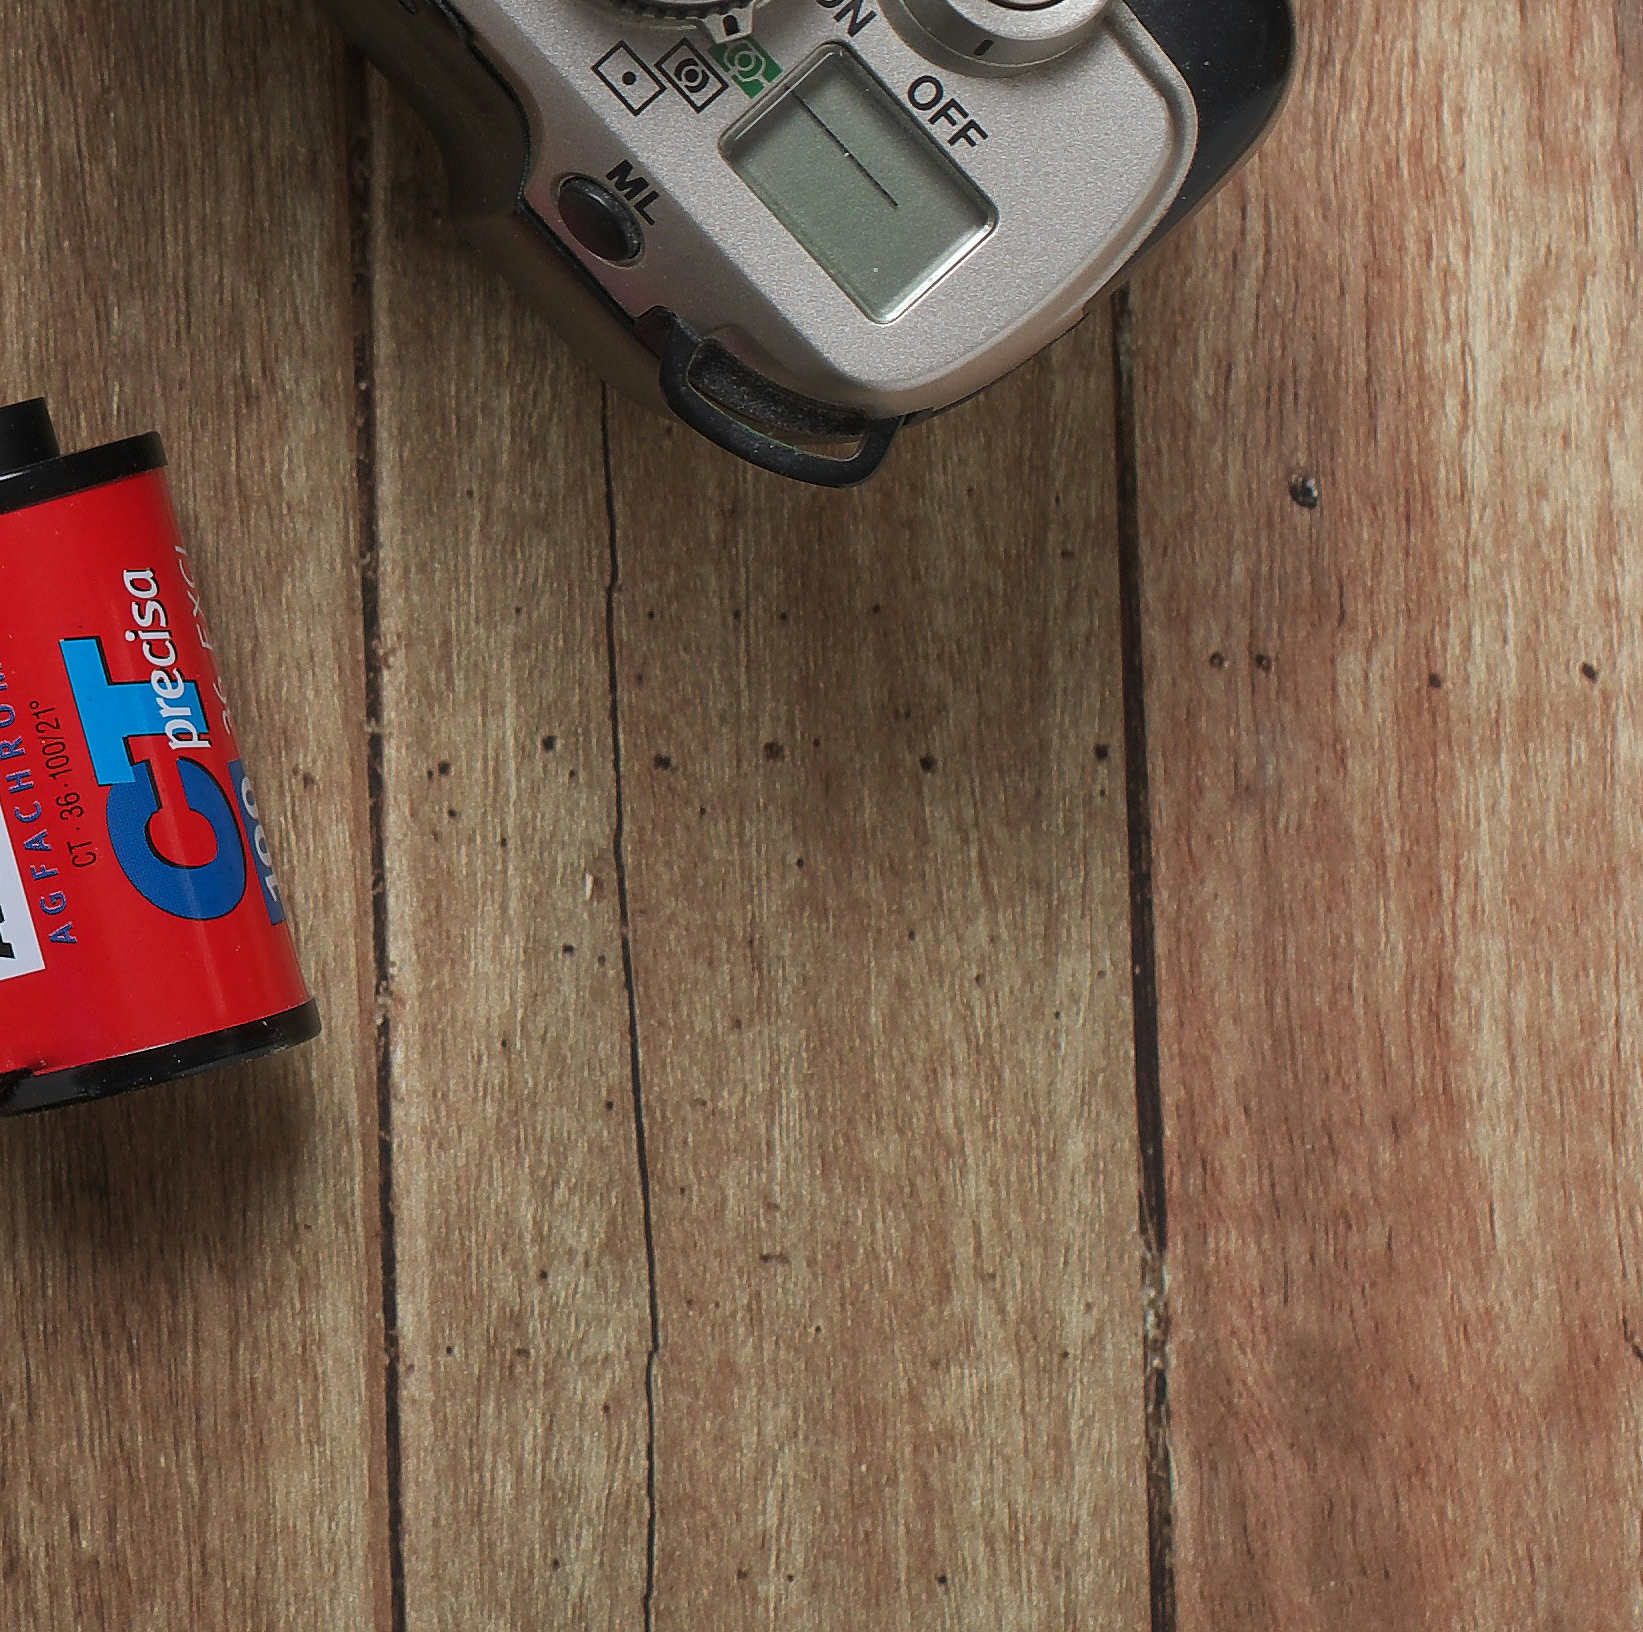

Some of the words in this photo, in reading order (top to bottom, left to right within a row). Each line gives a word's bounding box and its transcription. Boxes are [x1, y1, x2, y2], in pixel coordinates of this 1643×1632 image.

[907, 73, 989, 154] OFF
[604, 159, 659, 227] ML
[123, 569, 213, 750] precisa
[60, 637, 247, 921] CT
[65, 835, 97, 869] CT
